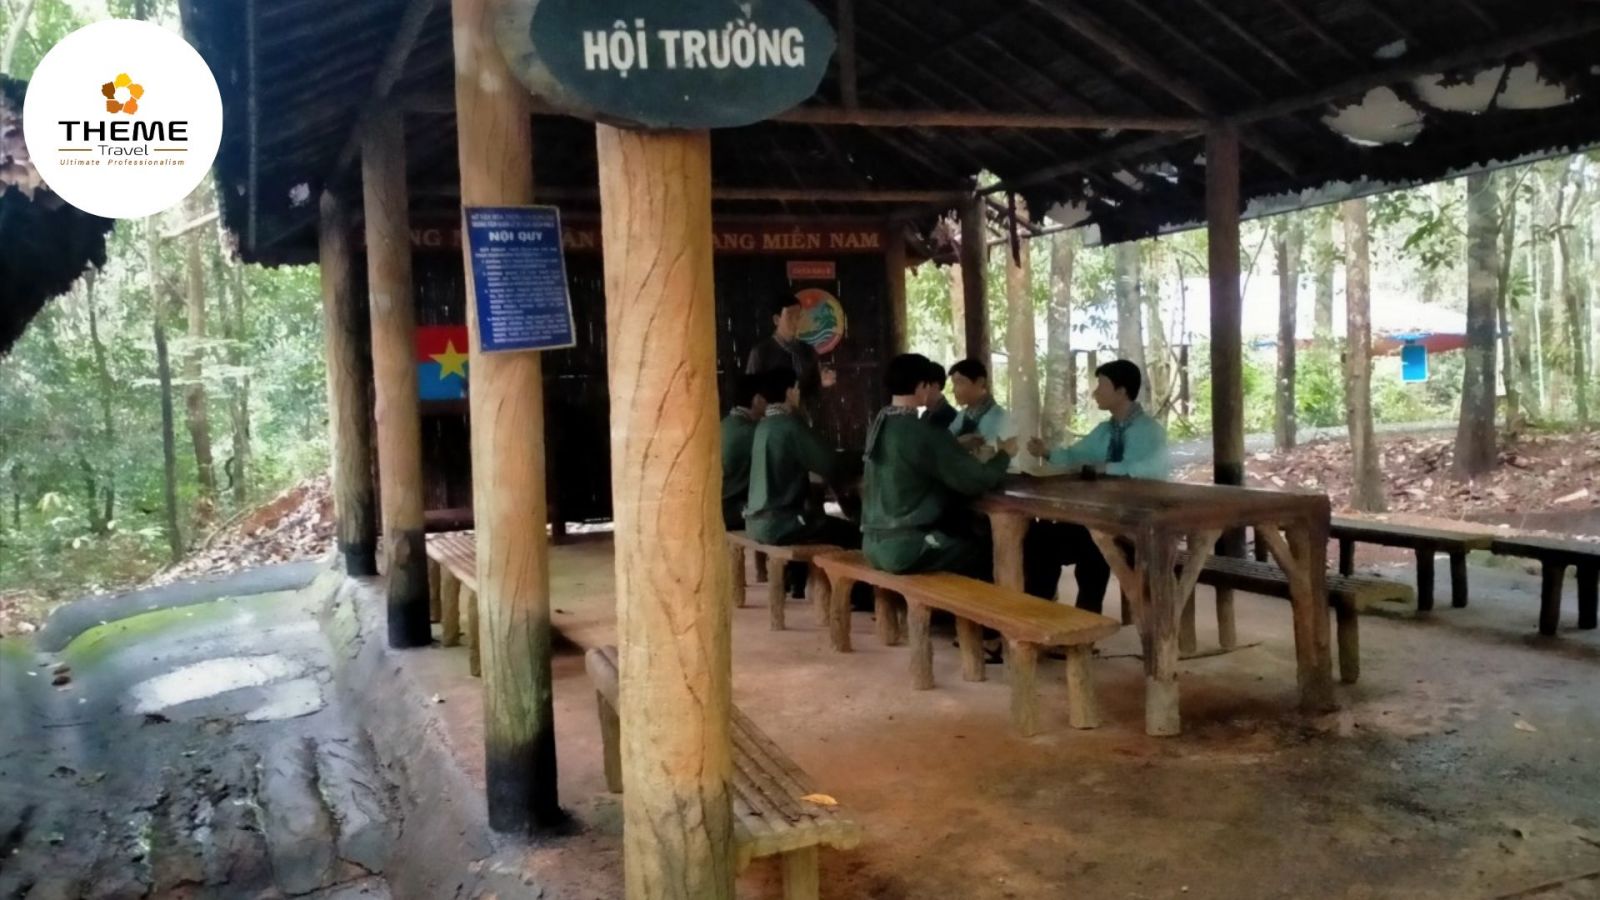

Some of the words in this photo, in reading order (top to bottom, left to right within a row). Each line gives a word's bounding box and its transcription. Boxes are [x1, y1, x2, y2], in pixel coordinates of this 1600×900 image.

[657, 18, 806, 70] TRƯỜNG
[488, 230, 514, 243] NỘI
[518, 231, 543, 242] QUY
[829, 232, 881, 249] NAM
